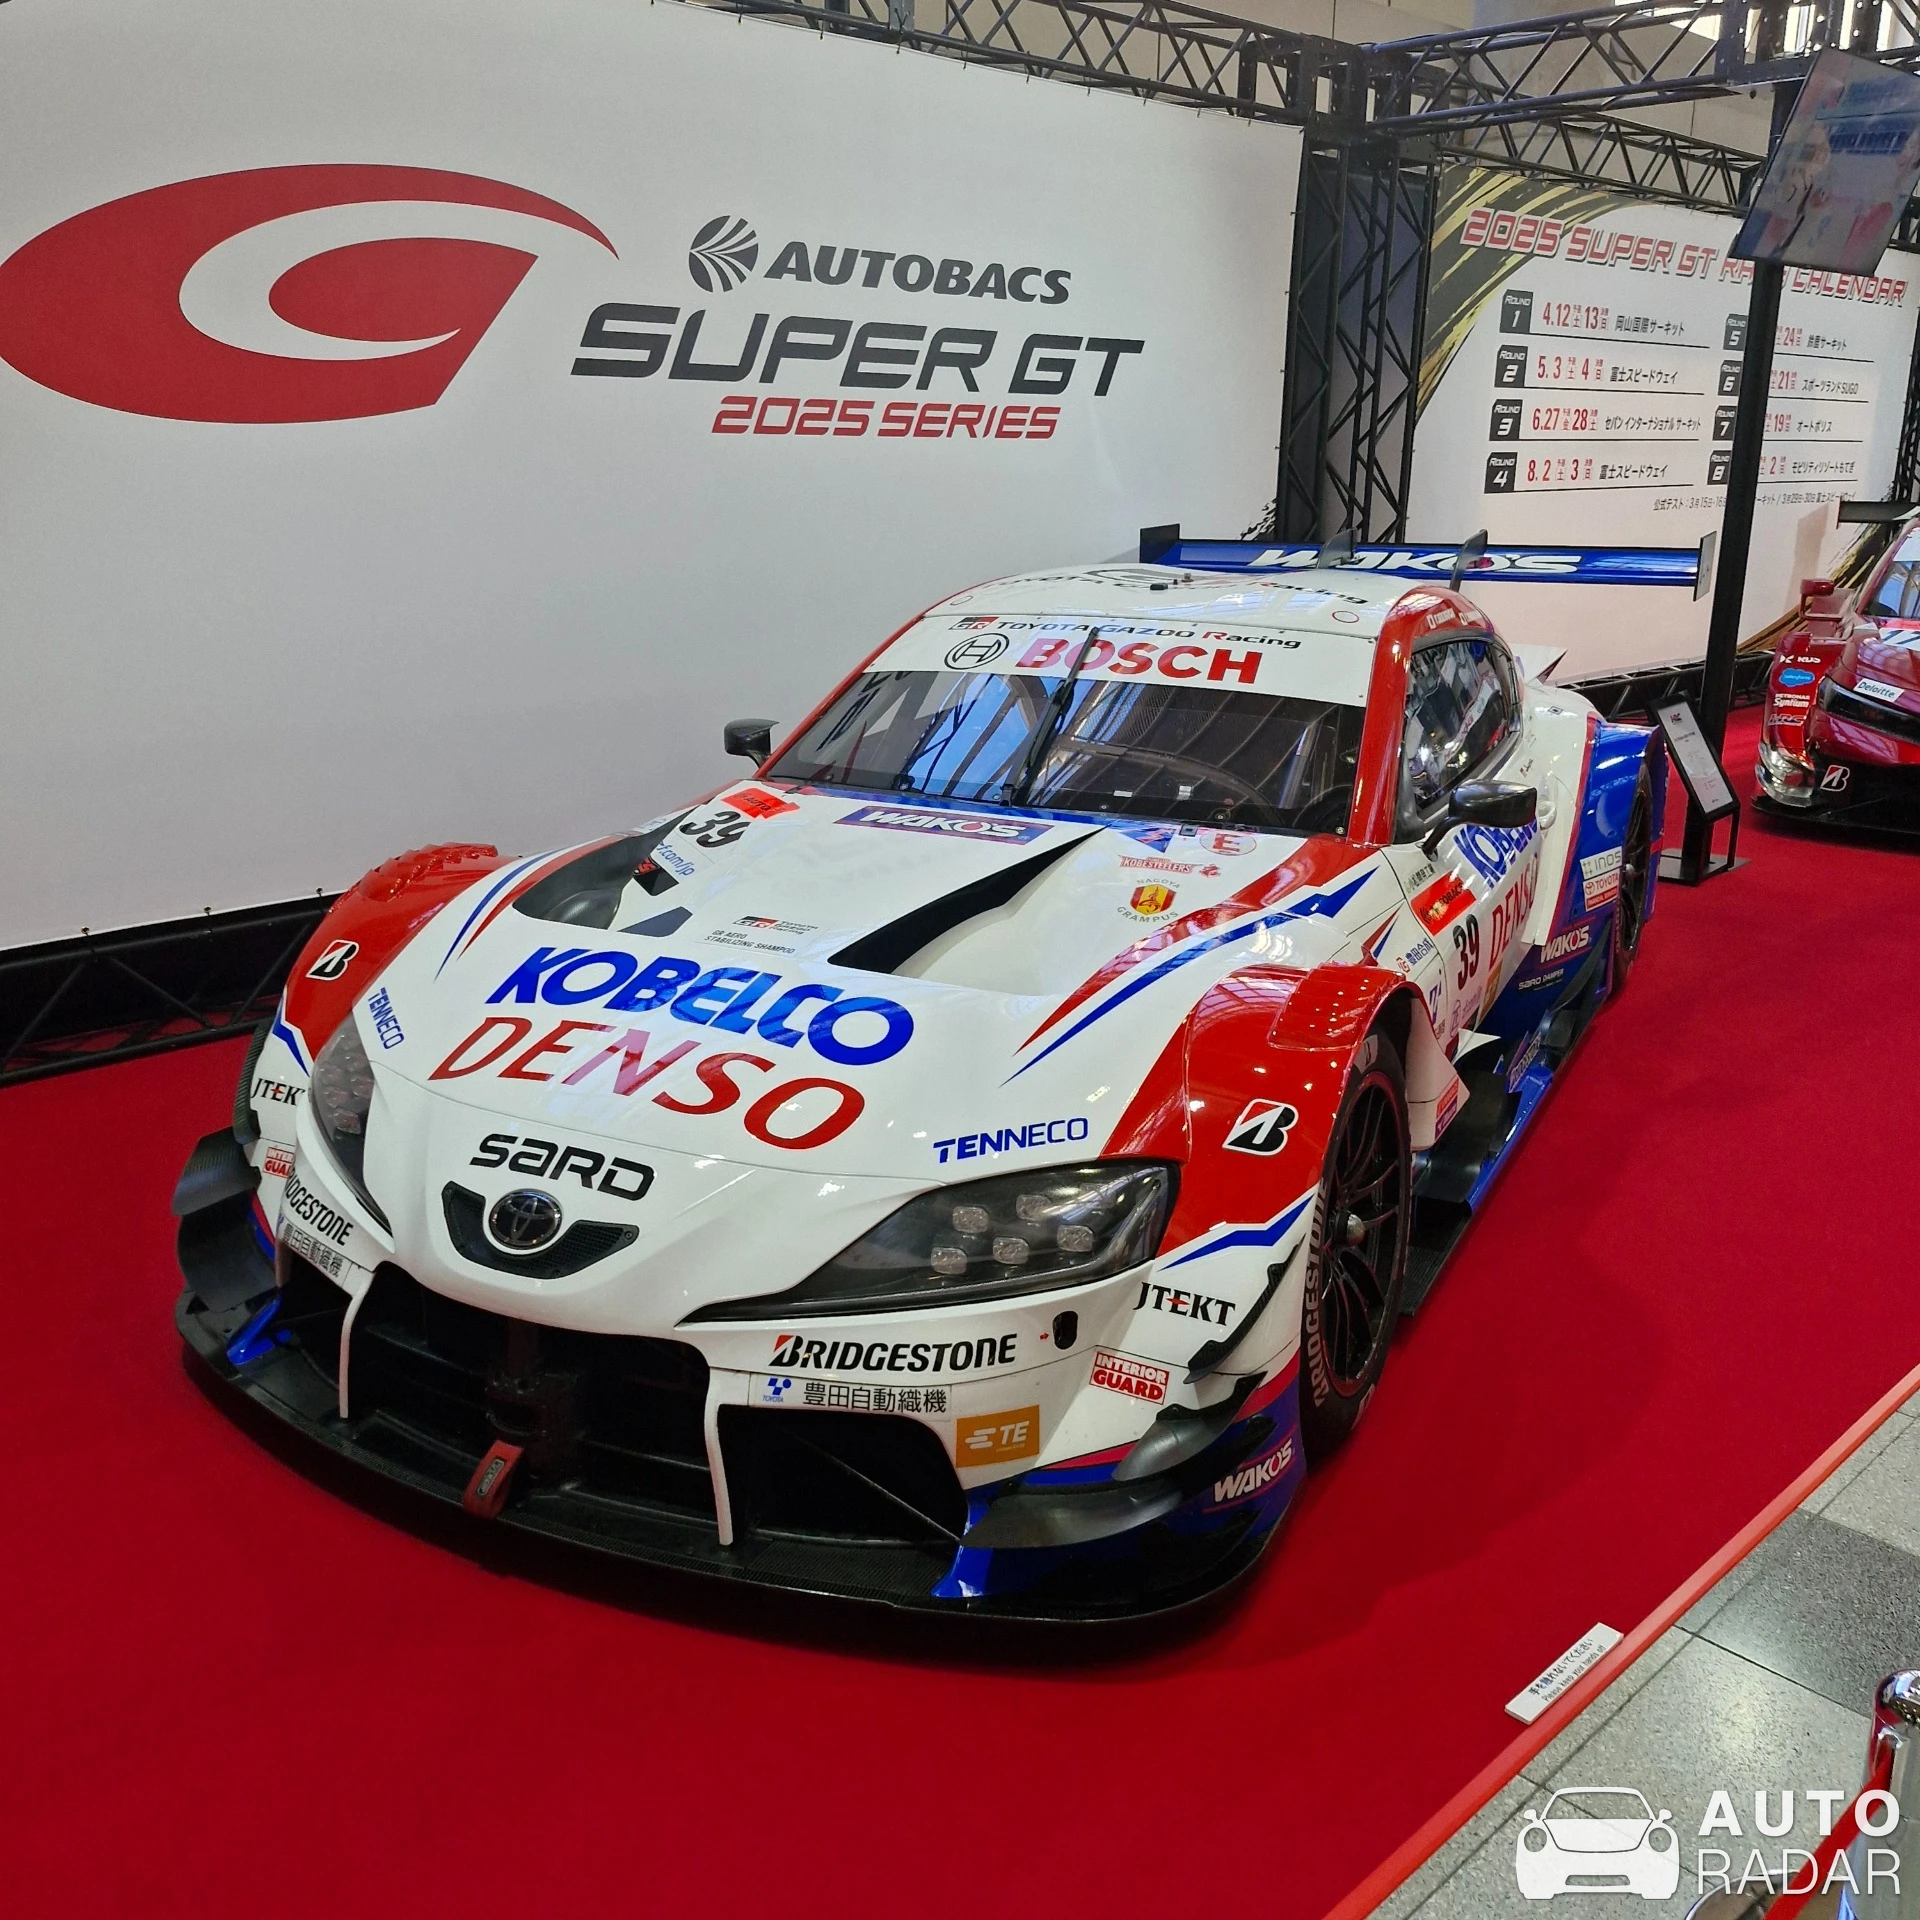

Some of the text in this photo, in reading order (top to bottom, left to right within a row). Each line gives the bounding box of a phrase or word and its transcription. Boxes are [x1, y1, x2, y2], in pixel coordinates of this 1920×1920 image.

[1461, 208, 1565, 257] 2025
[1566, 225, 1677, 272] SUPER
[1677, 245, 1719, 278] GT
[1791, 266, 1909, 307] CALENDAR
[764, 241, 1072, 305] AUTOBACS
[1512, 311, 1520, 328] 1
[1543, 302, 1569, 327] 4.12
[1585, 306, 1598, 329] 13
[1729, 330, 1741, 346] 5
[1783, 327, 1796, 346] 24
[570, 302, 1146, 397] SUPER GT
[1503, 365, 1518, 383] 2
[1581, 358, 1589, 380] 4
[1723, 376, 1736, 391] 6
[1778, 371, 1790, 390] 21
[711, 395, 1061, 439] 2025 SERIES
[1497, 418, 1513, 436] 3
[1532, 408, 1560, 431] 6.27
[1572, 409, 1588, 431] 28
[1774, 414, 1785, 432] 19
[1720, 422, 1730, 437] 7
[1571, 459, 1579, 480] 3
[1712, 465, 1726, 481] 8
[1769, 456, 1777, 475] 2
[1493, 470, 1509, 487] 4
[998, 620, 1089, 632] TOYOTA
[1098, 624, 1195, 638] GAZOO
[1201, 630, 1302, 649] Racing
[1015, 638, 1263, 685] BOSCH
[1858, 681, 1896, 698] Deloitte
[679, 810, 751, 848] 39
[1212, 832, 1244, 853] E
[1136, 878, 1180, 889] NAGOYA
[1117, 906, 1179, 923] GRAMPUS
[704, 936, 795, 954] STABILIZING SHAMPOO
[725, 931, 747, 939] AERO
[1452, 914, 1480, 991] 39
[485, 946, 915, 1066] KOBELCO
[368, 986, 405, 1050] TENNECO
[428, 1016, 866, 1150] DENSO
[933, 1117, 1089, 1164] TENNECO
[266, 1148, 295, 1164] INTER
[1133, 1281, 1236, 1326] JTEKT
[768, 1333, 1018, 1372] BRIDGESTONE
[1096, 1354, 1168, 1384] INTERIOR
[1093, 1369, 1165, 1402] GUARD
[803, 1382, 947, 1413] 豊田自動織機
[999, 1420, 1029, 1445] TE
[1528, 1638, 1593, 1696] 手を触れないでください
